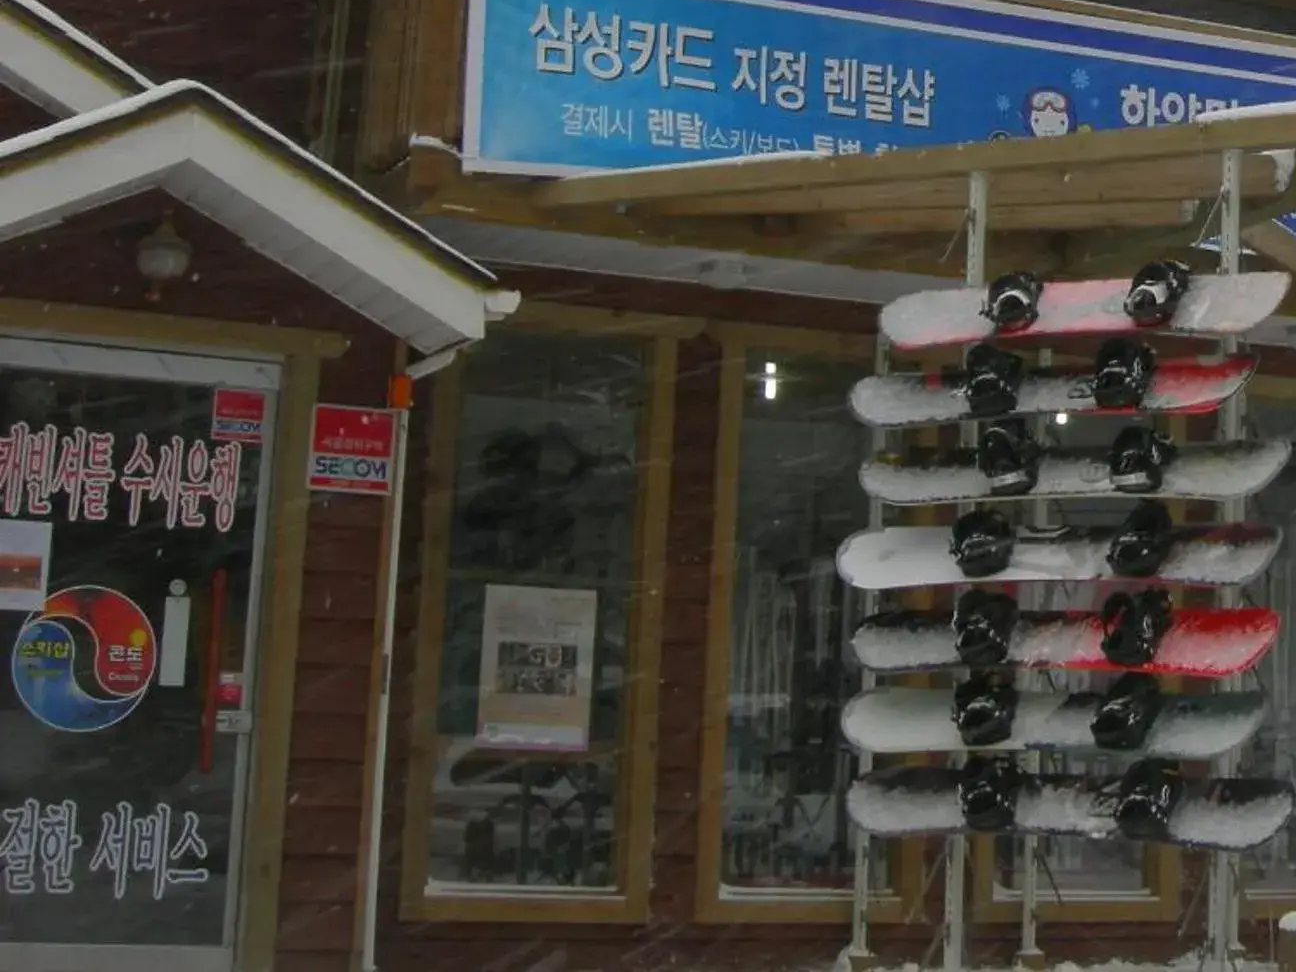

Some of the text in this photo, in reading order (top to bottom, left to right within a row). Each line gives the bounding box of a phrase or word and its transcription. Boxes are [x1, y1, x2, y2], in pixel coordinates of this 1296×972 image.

[529, 3, 936, 127] 삼성카드 지정 렌탈샵
[561, 103, 633, 143] 결제시
[120, 434, 242, 532] 수시운행
[315, 456, 387, 479] SECOM
[89, 801, 209, 900] 서비스
